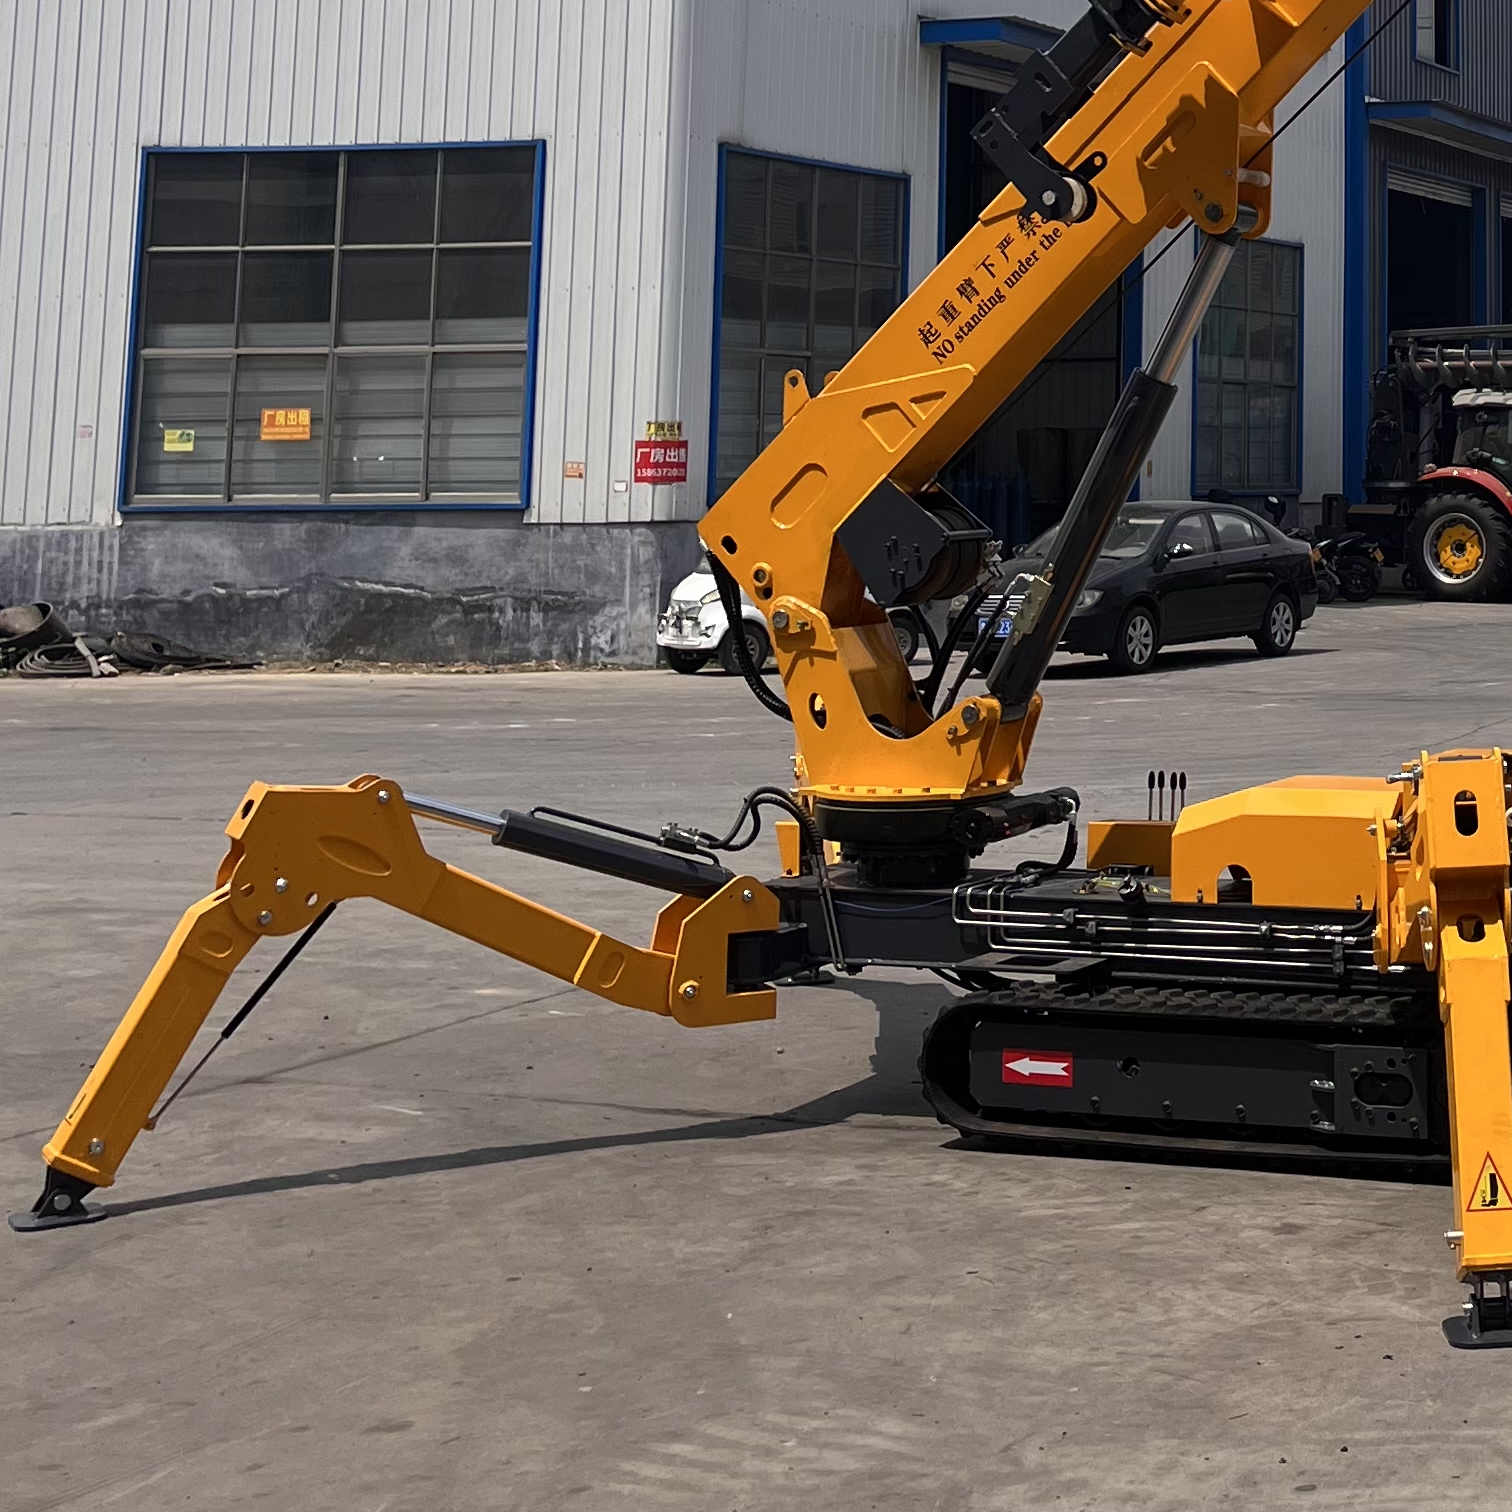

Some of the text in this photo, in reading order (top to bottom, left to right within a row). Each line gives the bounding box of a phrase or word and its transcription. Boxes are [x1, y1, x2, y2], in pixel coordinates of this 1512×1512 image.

[931, 227, 1063, 365] NO standing under the
